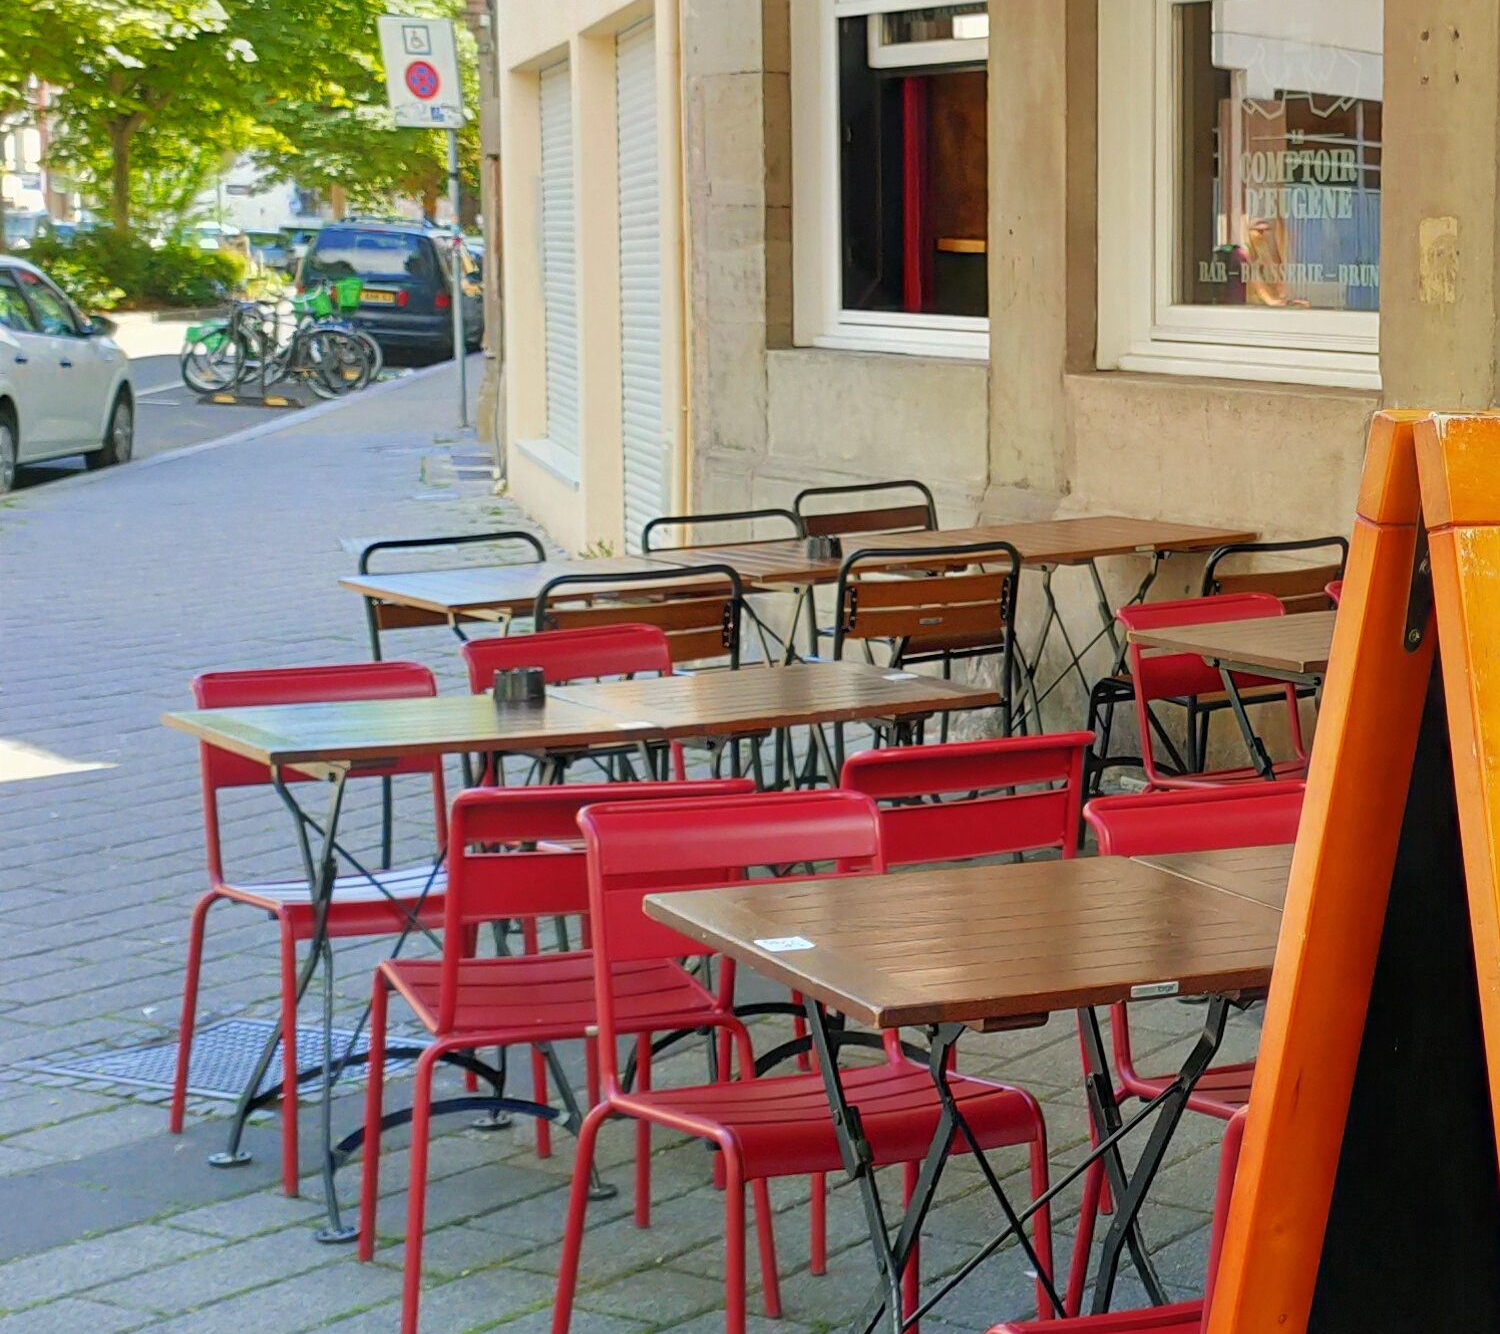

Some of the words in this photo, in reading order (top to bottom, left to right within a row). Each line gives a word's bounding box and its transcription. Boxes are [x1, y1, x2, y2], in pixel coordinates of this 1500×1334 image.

[1239, 148, 1358, 183] COMPTOIR
[1245, 180, 1353, 219] D'EUGÈNE
[1199, 260, 1228, 283] BAR
[1240, 261, 1324, 284] BRASSERIE
